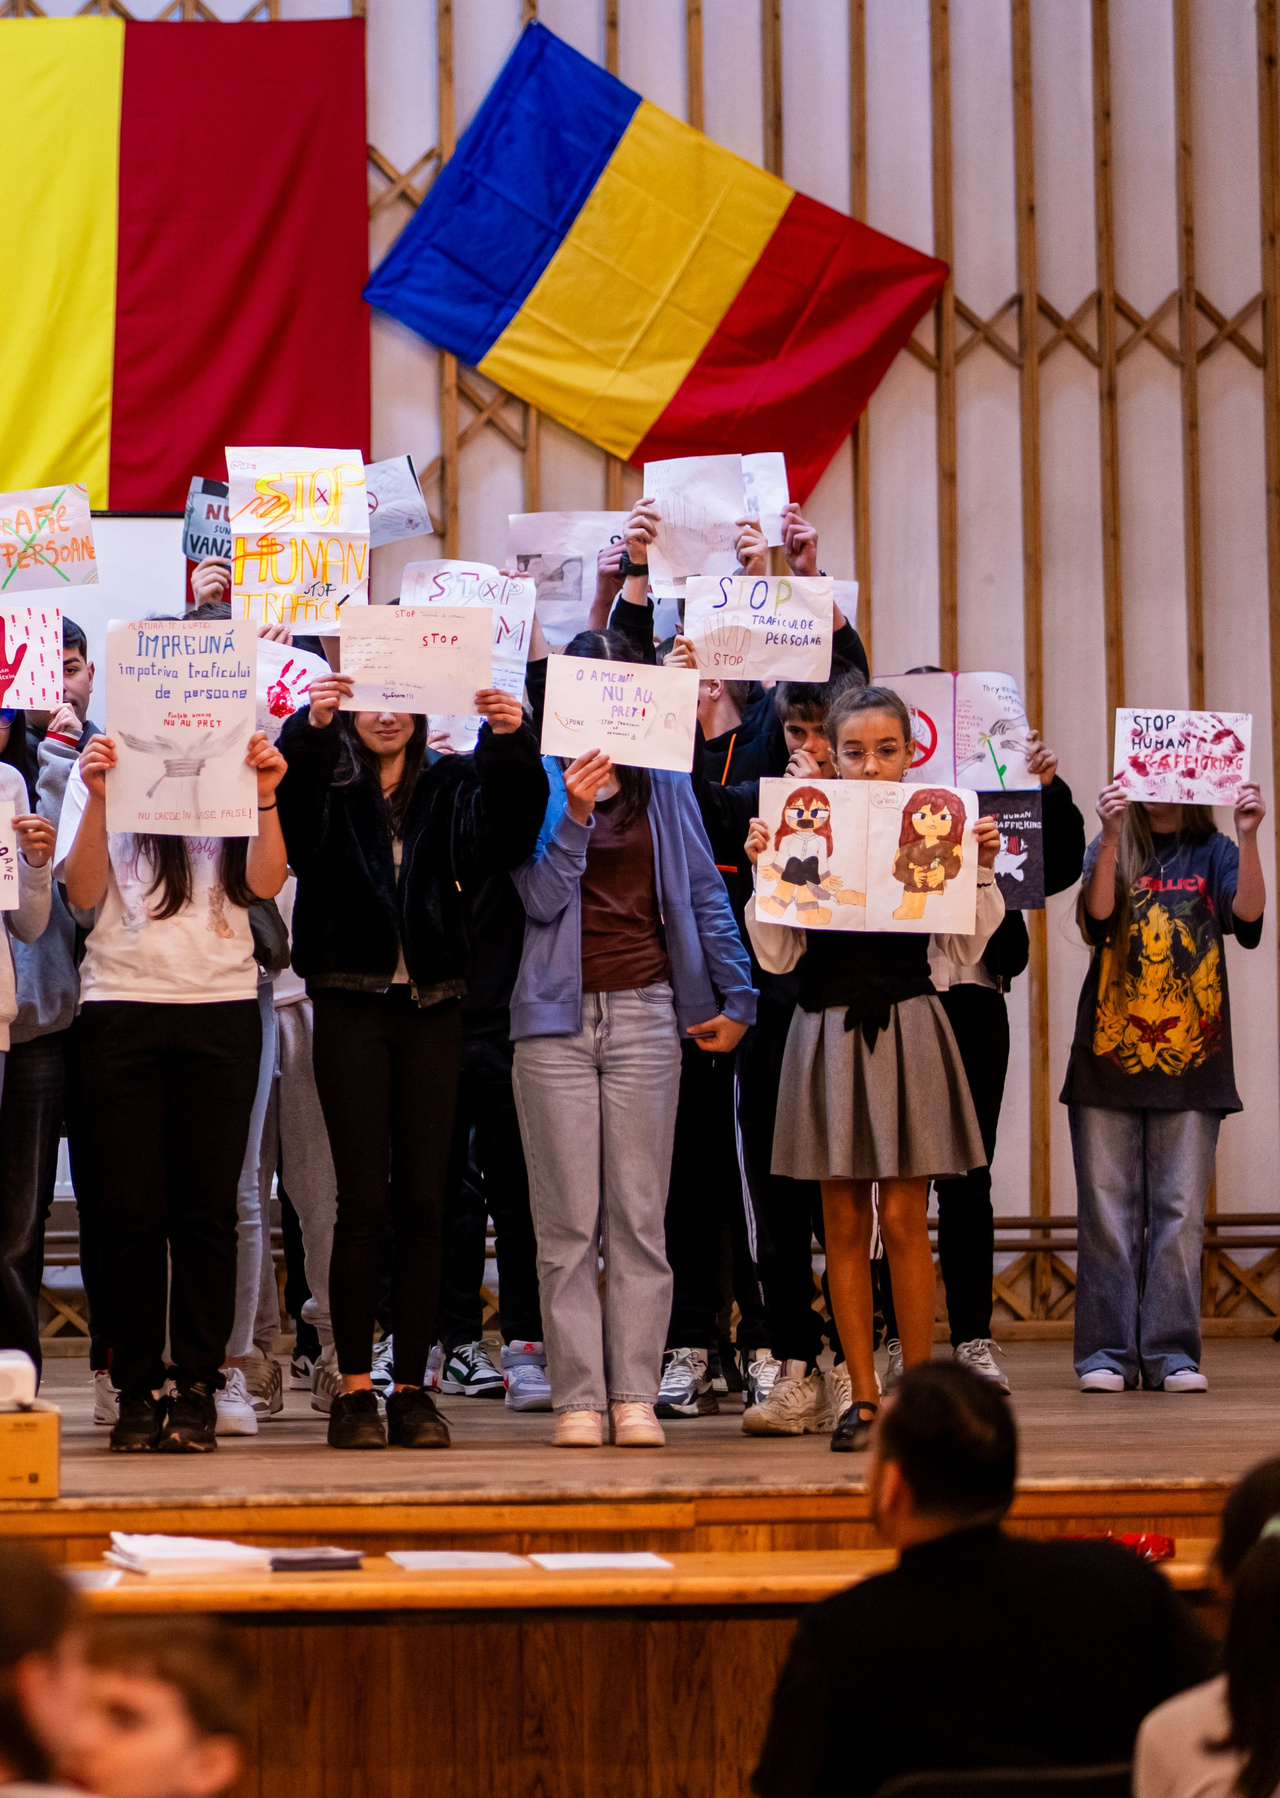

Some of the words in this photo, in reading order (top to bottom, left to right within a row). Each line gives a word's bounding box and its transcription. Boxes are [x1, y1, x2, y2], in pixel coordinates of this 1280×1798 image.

[255, 465, 366, 526] STOP
[214, 525, 231, 534] SUN
[233, 536, 368, 585] HUMAN
[712, 576, 793, 616] STOP
[395, 609, 416, 619] STOP
[422, 633, 459, 647] STOP
[713, 653, 744, 666] STOP
[155, 684, 171, 699] de
[184, 689, 248, 703] persoane
[602, 686, 624, 702] NU
[634, 687, 653, 704] AU
[180, 719, 191, 727] AU
[565, 718, 584, 726] SPUNE
[1133, 714, 1176, 737] STOP
[1132, 737, 1188, 751] HUMAN
[138, 811, 150, 820] NU
[1003, 811, 1031, 819] HUMAN
